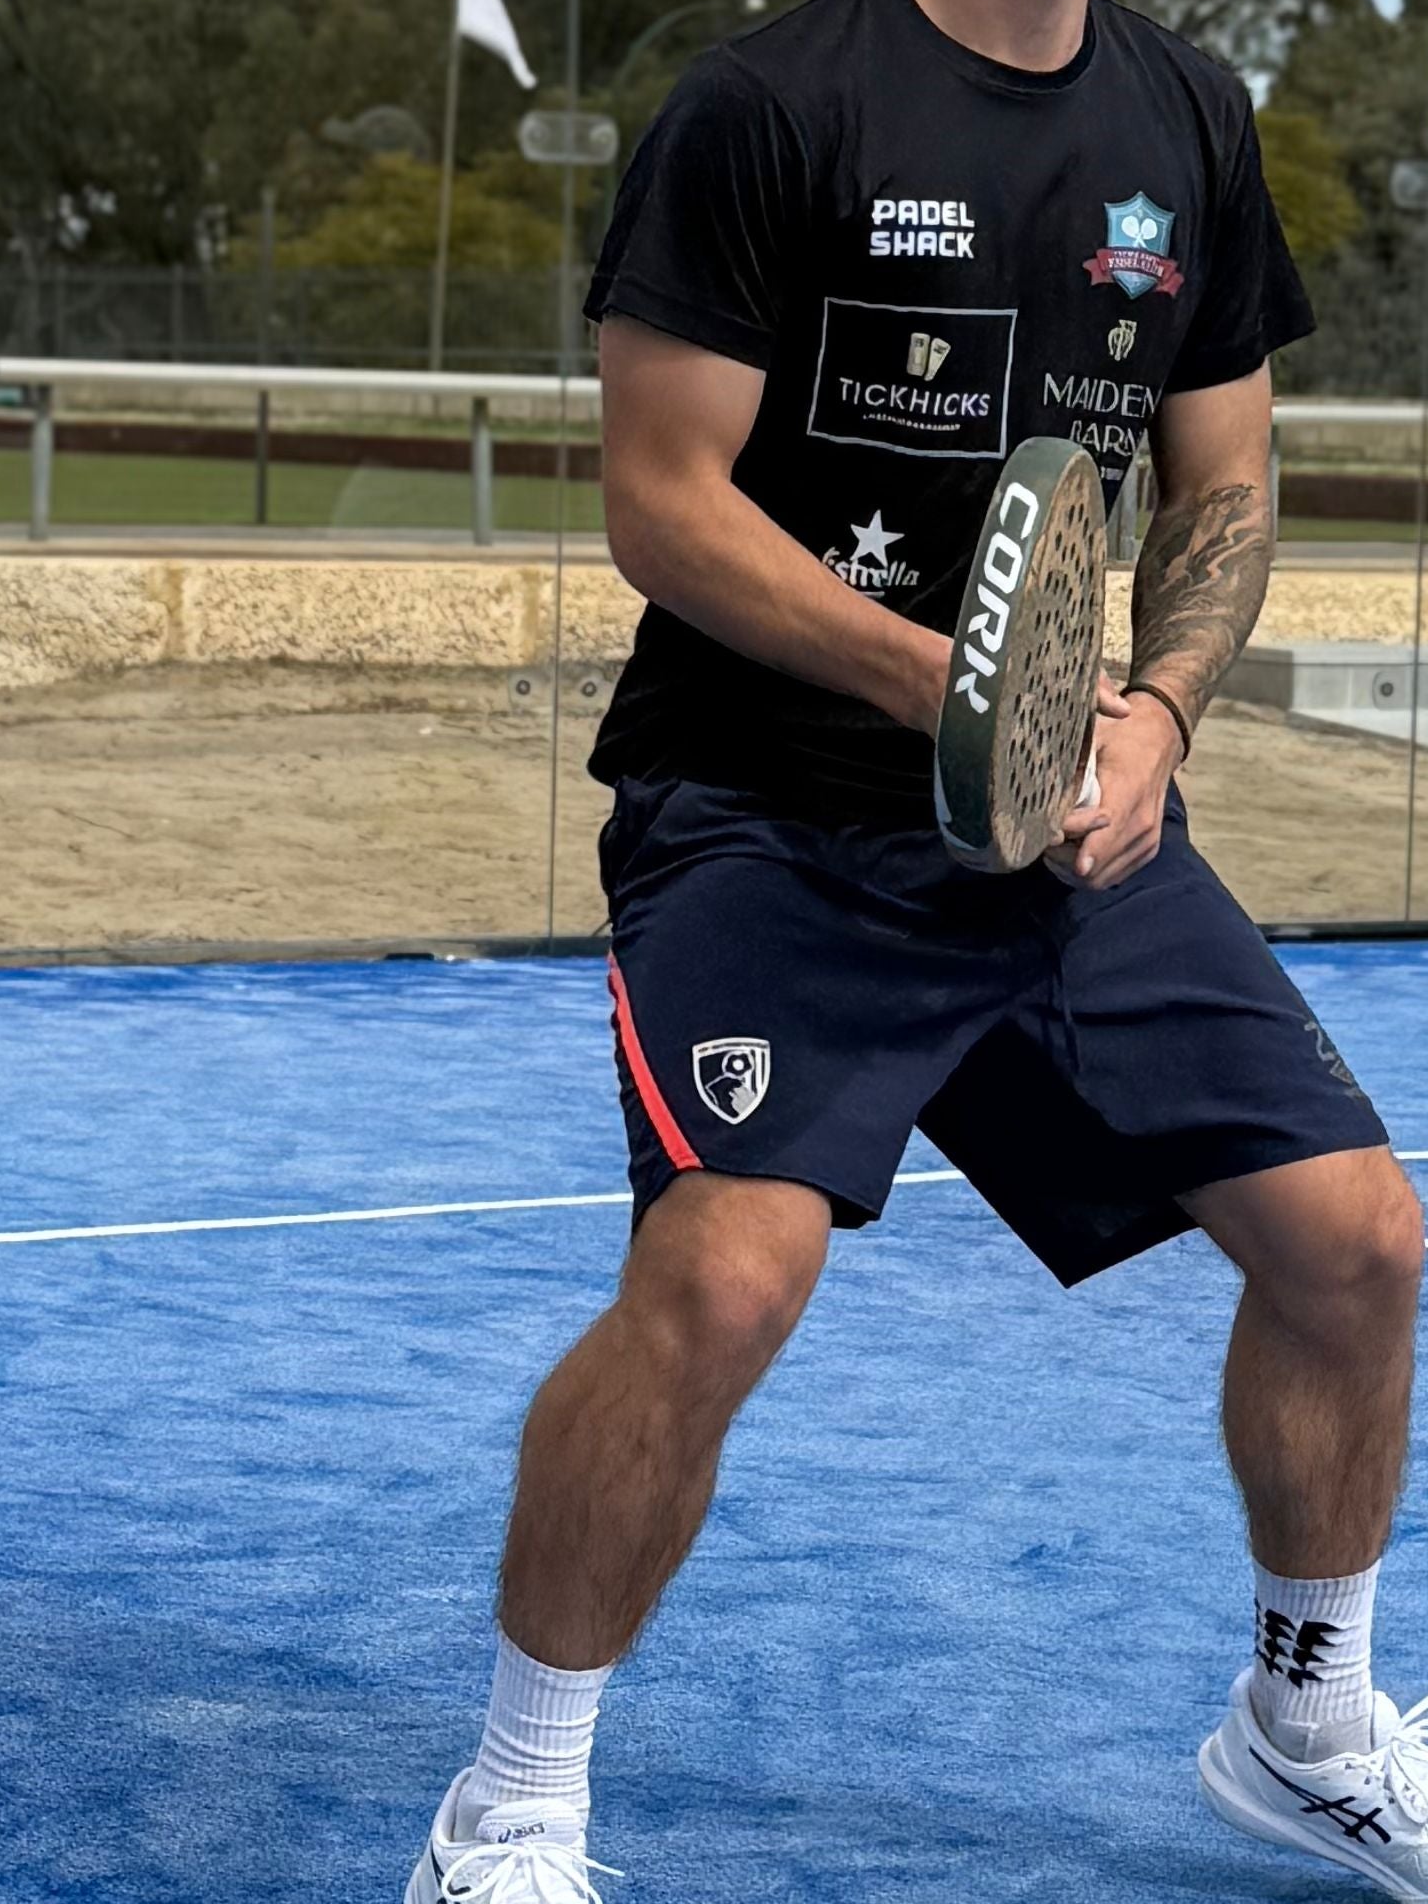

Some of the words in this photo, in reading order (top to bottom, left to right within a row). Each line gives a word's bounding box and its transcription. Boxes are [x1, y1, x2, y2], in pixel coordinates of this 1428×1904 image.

[872, 199, 975, 228] PADEL
[869, 231, 974, 259] SHACK
[839, 377, 991, 417] TICKHICKS
[1043, 372, 1165, 418] MAIDEN
[955, 481, 1039, 714] CORK
